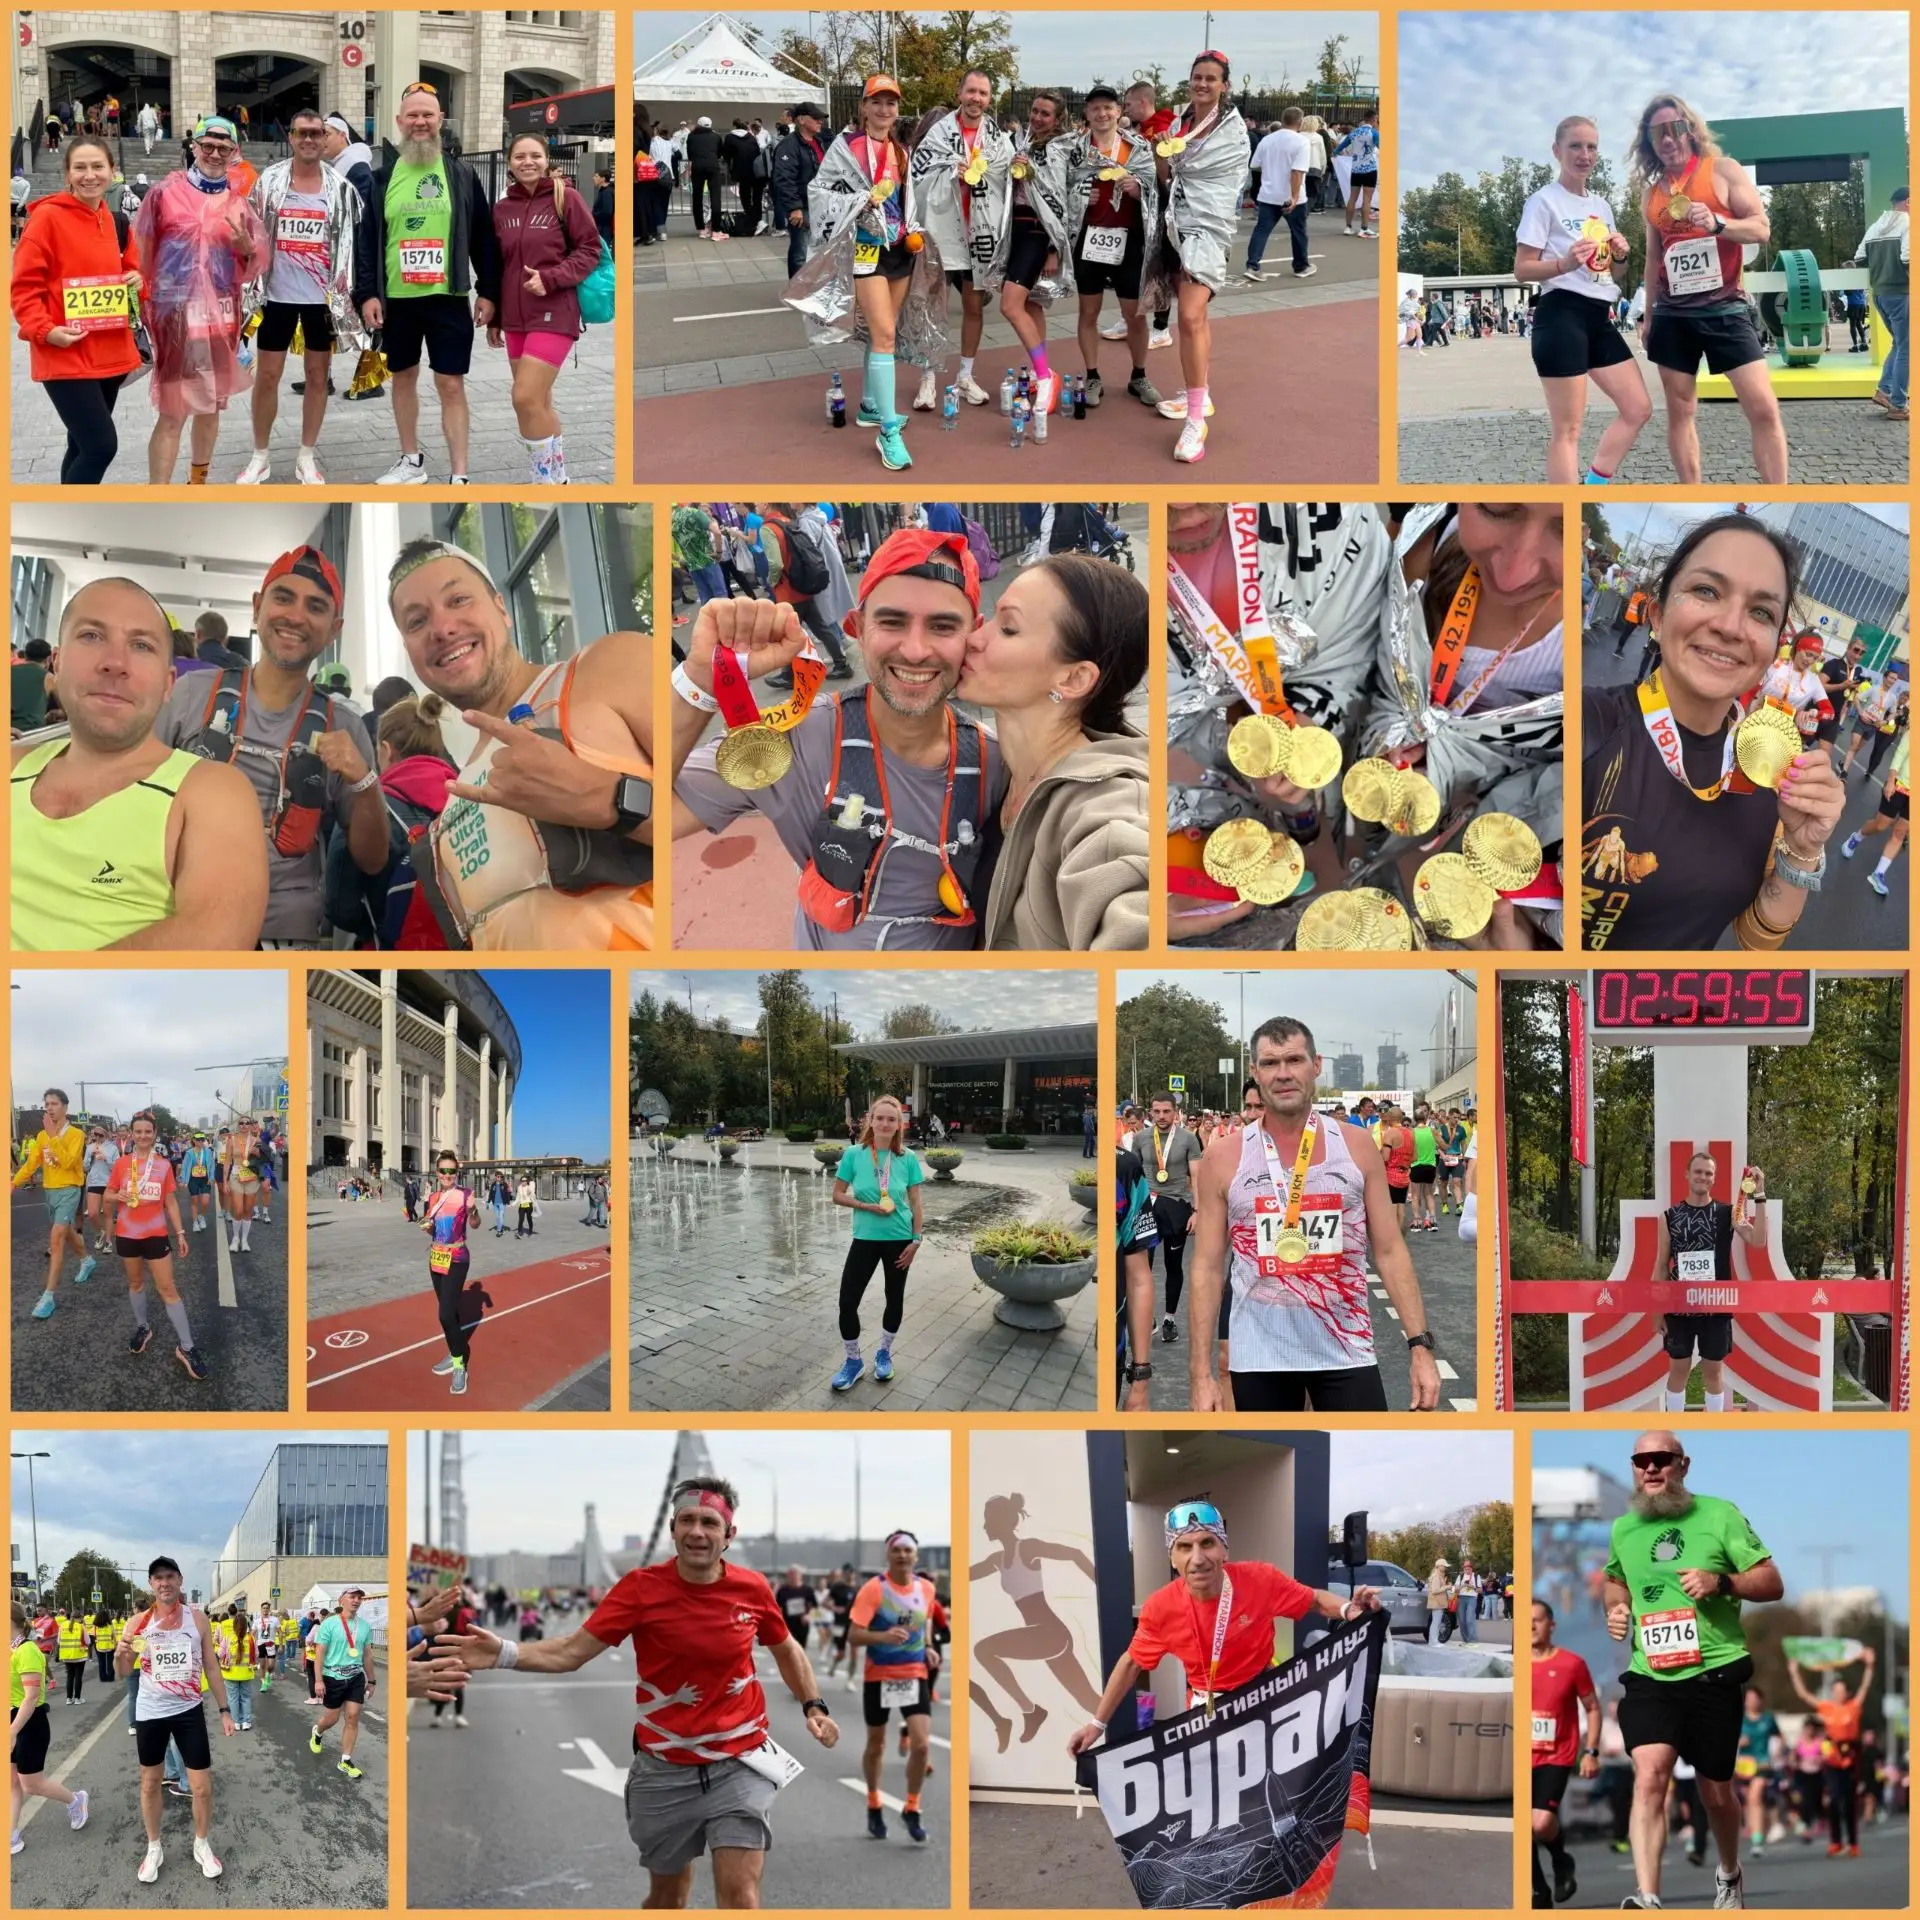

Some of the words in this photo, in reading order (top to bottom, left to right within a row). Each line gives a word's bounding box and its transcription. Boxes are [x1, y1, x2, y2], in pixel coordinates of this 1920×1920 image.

[340, 20, 365, 40] 10
[347, 49, 357, 63] C
[700, 68, 769, 79] БАЛТИКА
[280, 219, 323, 235] 11047
[1090, 233, 1122, 249] 6339
[402, 250, 443, 265] 15716
[1670, 251, 1710, 273] 7521
[66, 288, 125, 309] 21299
[1443, 583, 1477, 652] 42.195
[448, 811, 486, 850] Ultra
[455, 827, 489, 863] Trail
[459, 847, 491, 882] 100
[1600, 971, 1803, 1025] 02:59:55
[1290, 1193, 1300, 1204] 10
[1261, 1214, 1340, 1242] 1047
[1266, 1258, 1277, 1274] B
[1682, 1259, 1710, 1271] 7838
[1686, 1287, 1739, 1307] ФИНИШ
[1643, 1623, 1695, 1646] 15716
[156, 1653, 187, 1666] 9582
[1163, 1661, 1308, 1746] СПОРТИВНЫЙ
